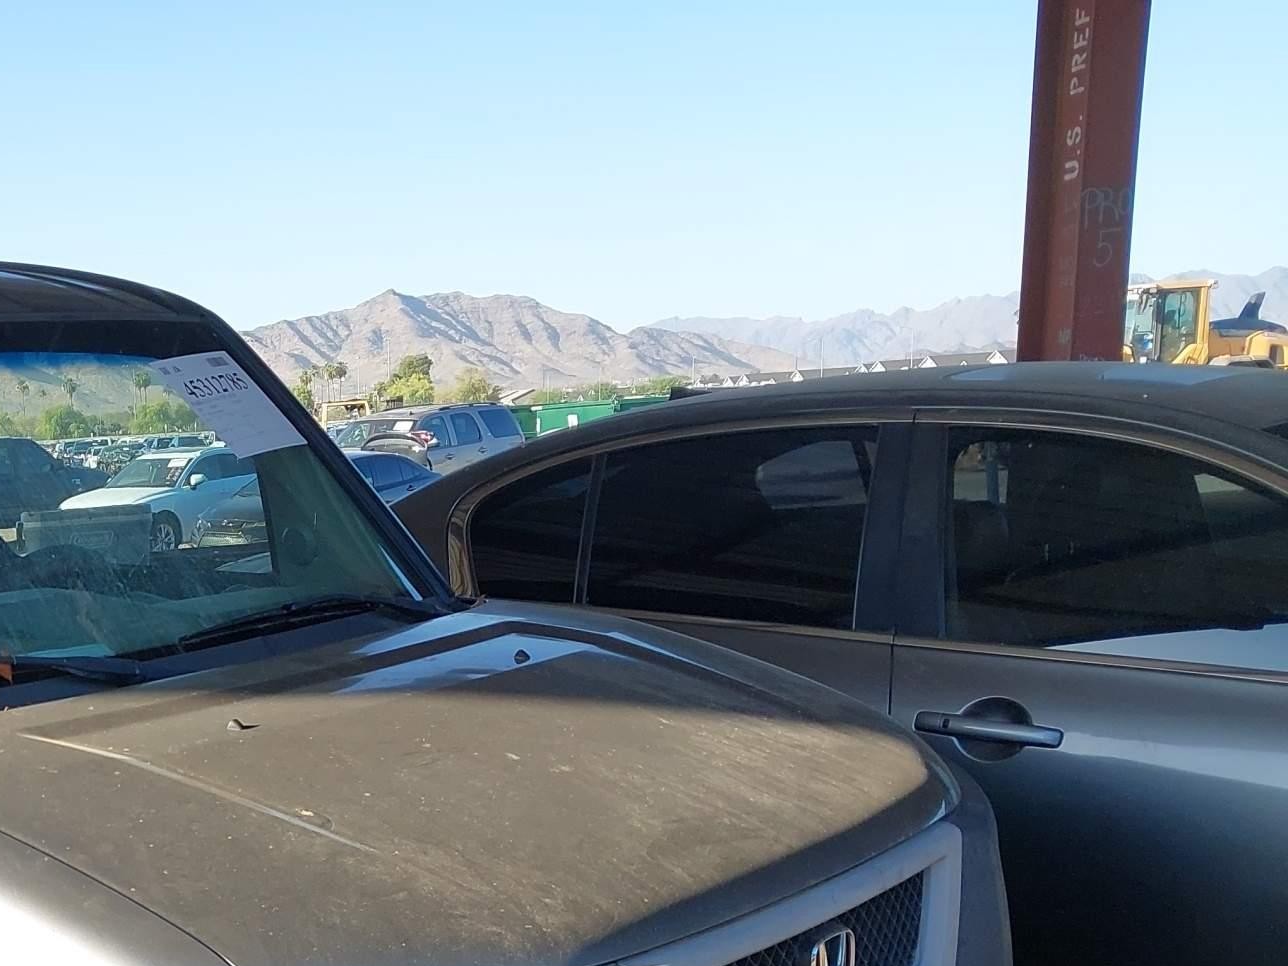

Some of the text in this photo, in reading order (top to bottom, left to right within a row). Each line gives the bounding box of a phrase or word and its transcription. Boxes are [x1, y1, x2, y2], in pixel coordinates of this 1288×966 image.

[1064, 8, 1091, 181] U.S. PREF
[183, 372, 249, 398] 45312785
